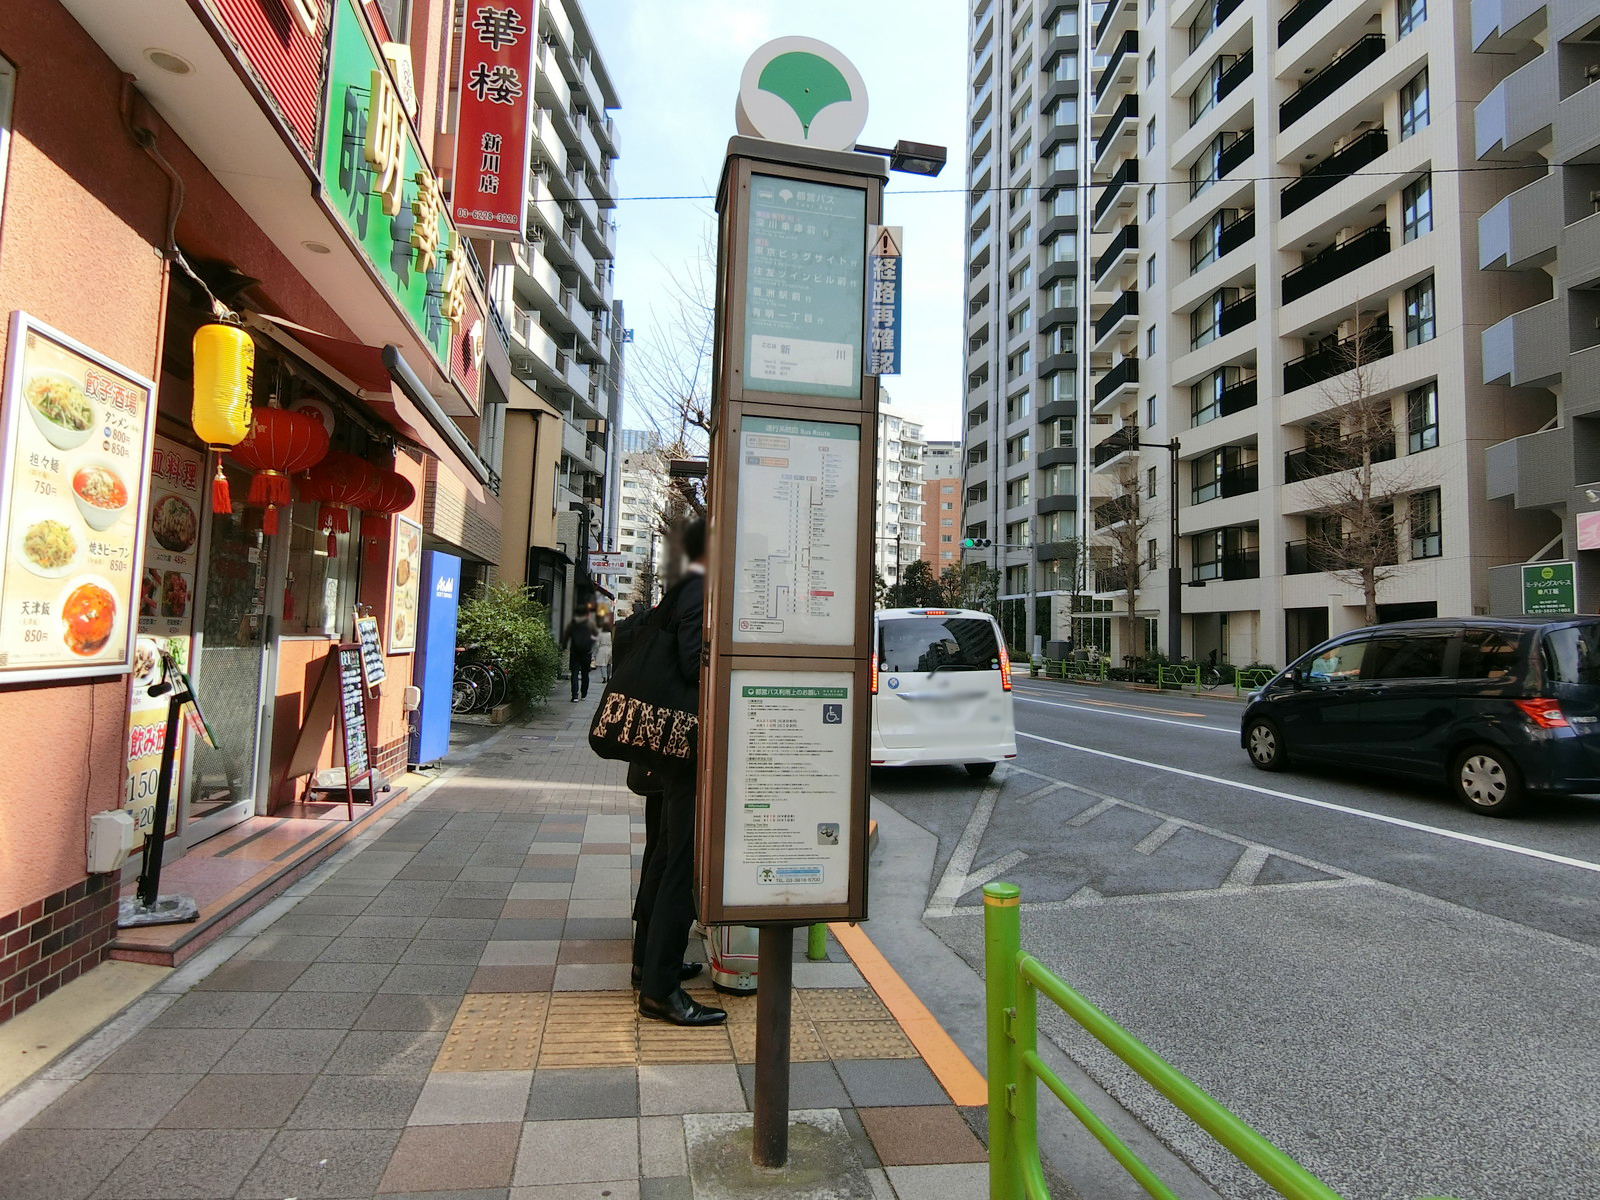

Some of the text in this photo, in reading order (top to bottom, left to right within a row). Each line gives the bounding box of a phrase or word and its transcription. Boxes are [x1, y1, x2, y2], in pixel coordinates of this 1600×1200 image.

[478, 133, 502, 194] 新川店
[457, 208, 518, 224] 03-6228-3229
[754, 246, 847, 265] 東京ビッグサイト
[753, 266, 847, 287] 住友ツインビル前
[753, 287, 801, 302] 豊洲駅前
[752, 308, 813, 323] 有明一丁目
[872, 257, 896, 375] 経路再確認
[85, 368, 138, 418] 餃子酒場
[105, 411, 130, 430] タンメン
[112, 428, 130, 445] 800円
[111, 443, 130, 458] 850円
[34, 480, 58, 497] 750円
[88, 541, 130, 559] 焼きビーフン
[109, 559, 128, 572] 850円
[21, 601, 51, 616] 天津飯
[24, 629, 49, 642] 850円
[755, 688, 820, 696] 都営バス利用上のお願い
[592, 692, 699, 759] PINK
[129, 722, 181, 761] 飲み放
